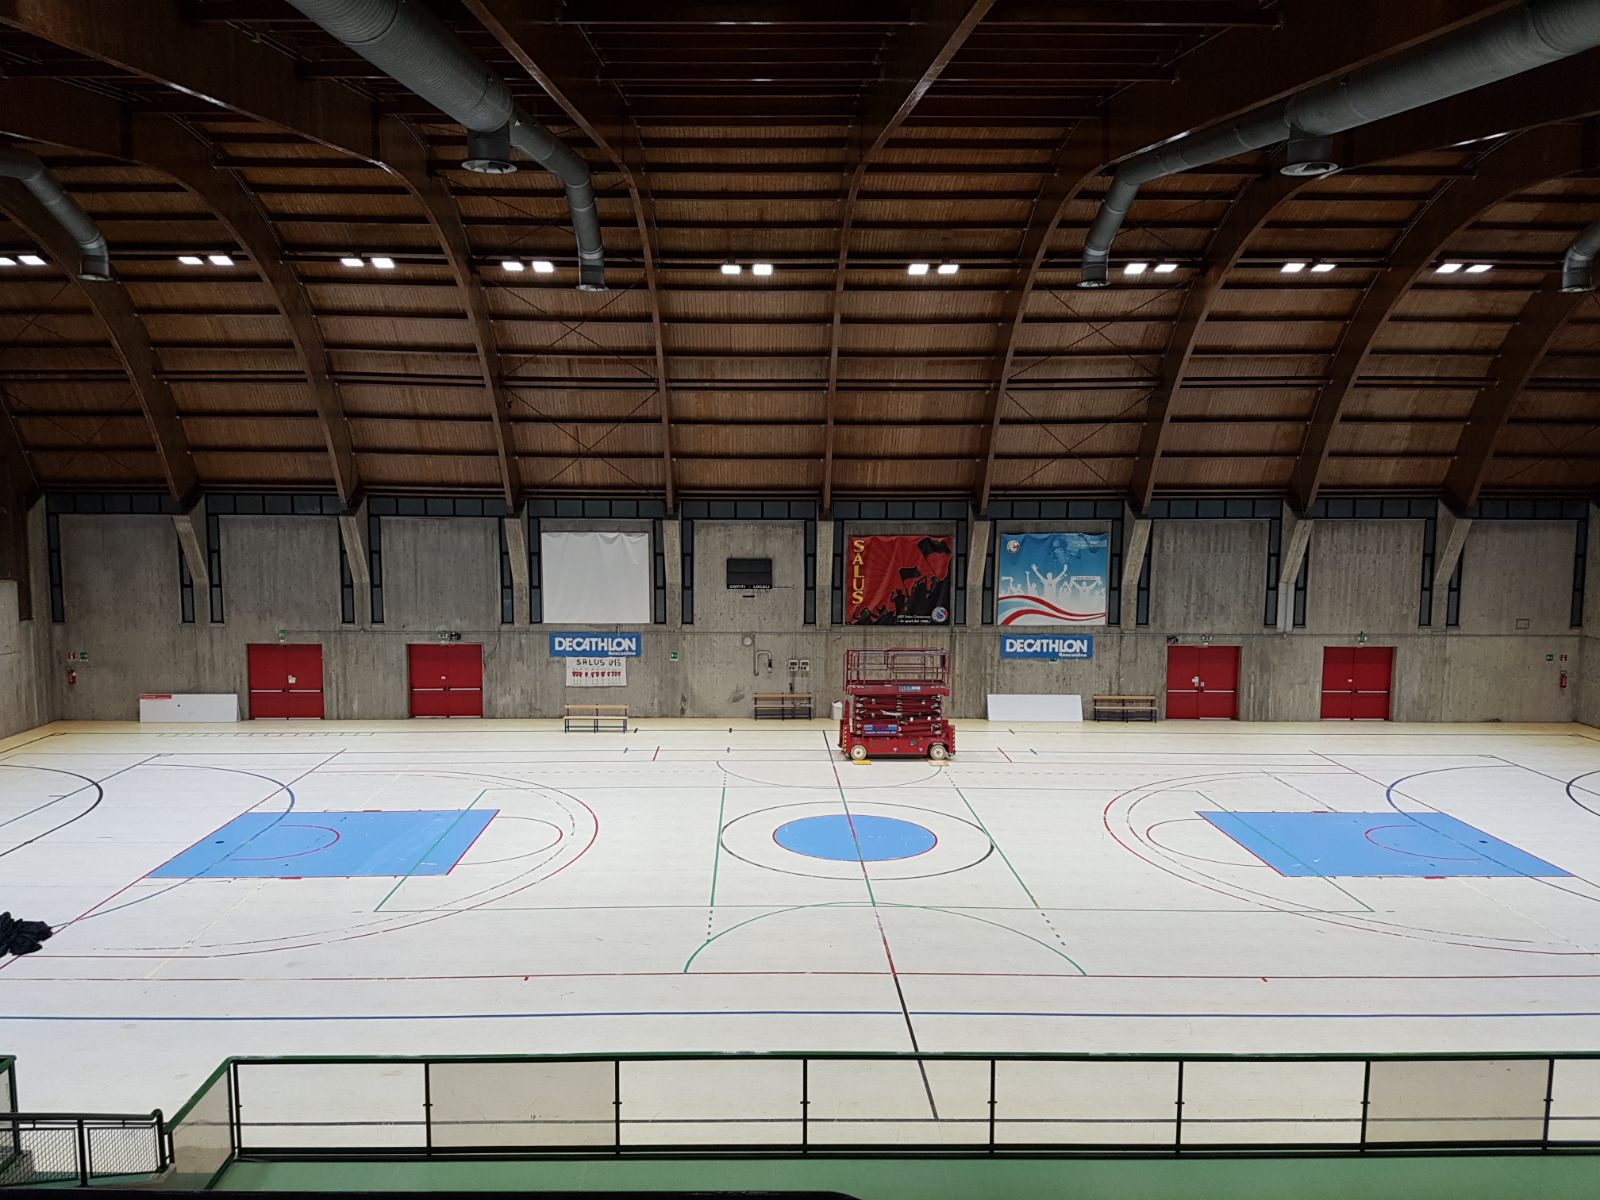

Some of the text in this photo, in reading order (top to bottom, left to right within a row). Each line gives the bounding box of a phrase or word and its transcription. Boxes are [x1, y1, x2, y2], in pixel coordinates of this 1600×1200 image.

[852, 539, 865, 604] SALUS
[554, 637, 637, 651] DECATHLON
[1005, 639, 1088, 653] DECATHLON
[576, 658, 605, 666] SALUS
